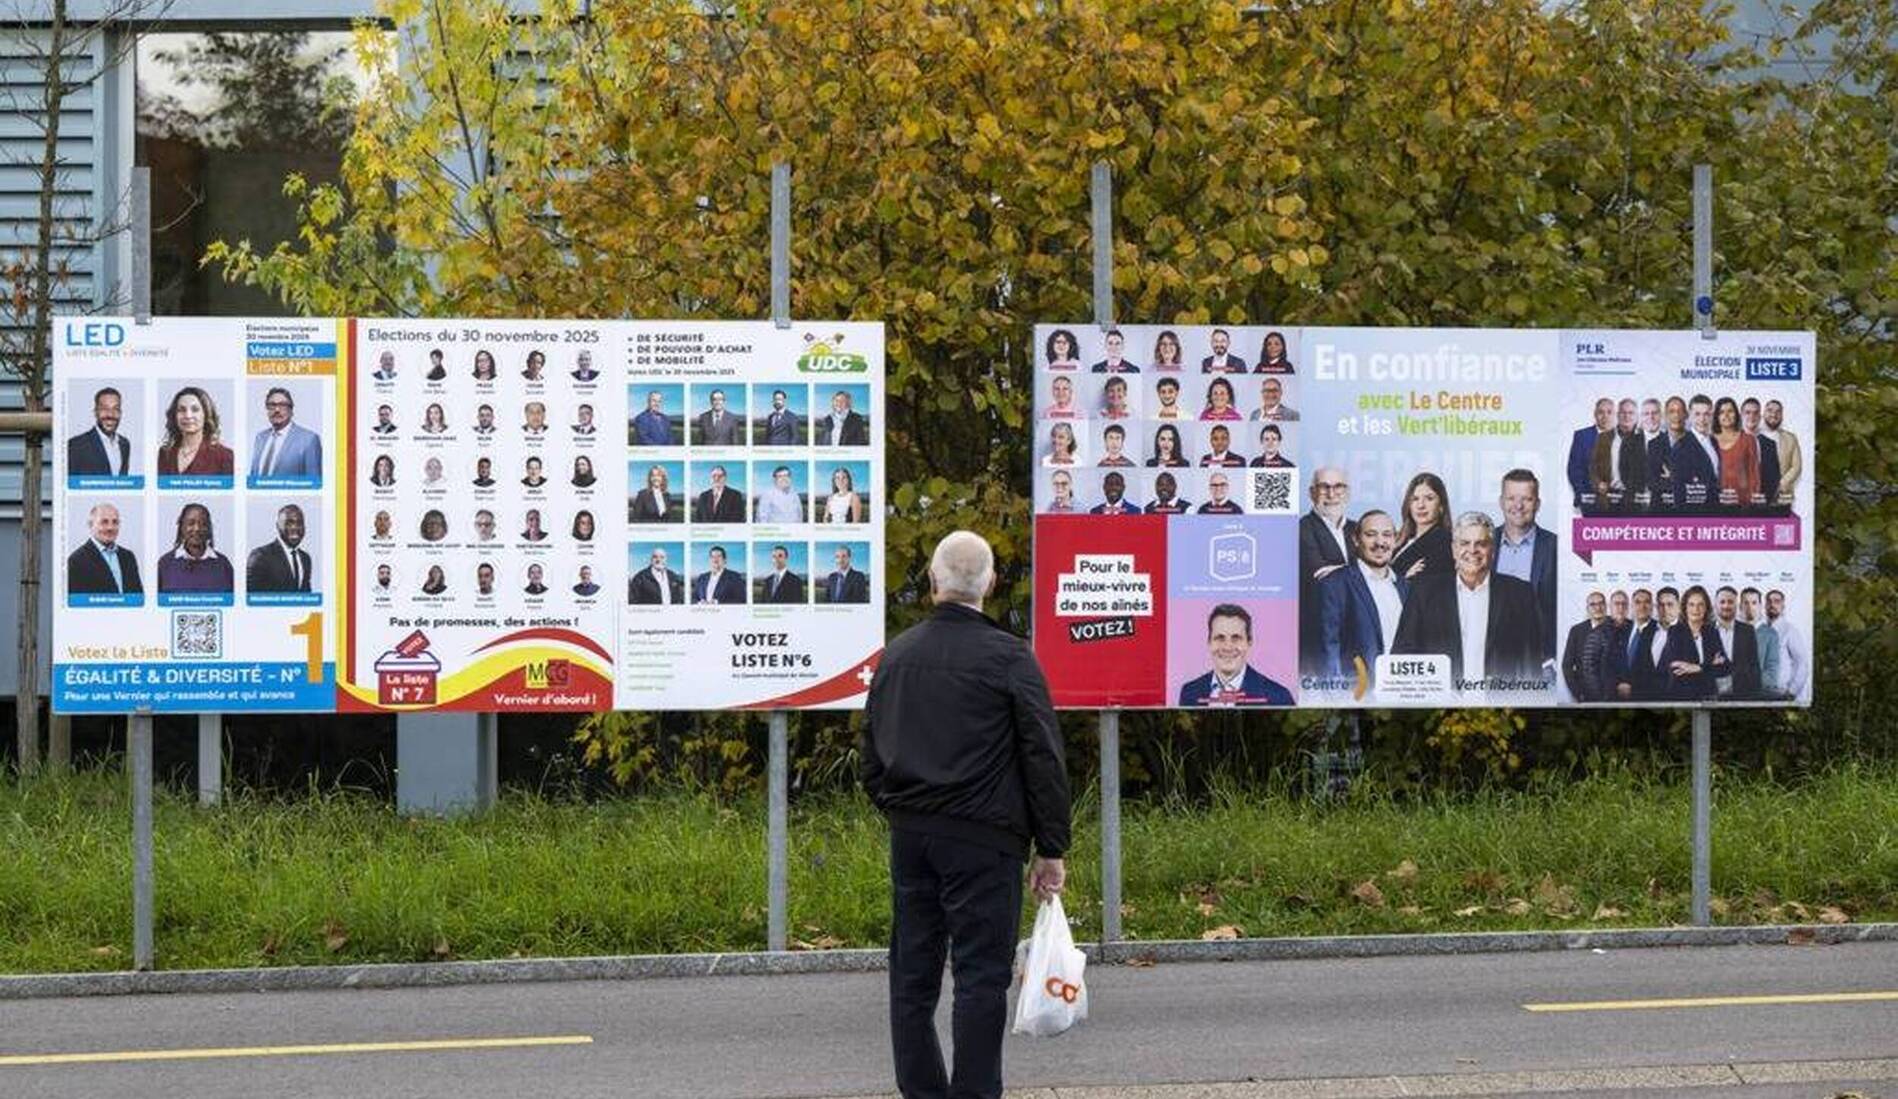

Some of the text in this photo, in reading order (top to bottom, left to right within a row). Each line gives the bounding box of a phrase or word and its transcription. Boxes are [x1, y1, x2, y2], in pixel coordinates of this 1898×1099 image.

[67, 324, 125, 346] LED
[369, 328, 599, 343] Elections du 30 novembre 2025
[637, 332, 704, 342] DE SÉCURITÉ
[250, 345, 315, 356] Votez LED
[637, 345, 752, 353] DE POUVOIR D'ACHAT
[1576, 344, 1605, 354] PLR
[250, 360, 287, 373] Liste
[637, 355, 704, 364] DE MOBILITÉ
[808, 356, 854, 371] UDC
[1315, 343, 1547, 382] En confiance
[1680, 368, 1740, 379] MUNICIPALE
[1750, 362, 1798, 376] LISTE 3
[1358, 391, 1503, 410] avec Le Centre
[1337, 414, 1523, 435] et les Vert'libéraux
[1582, 523, 1767, 541] COMPÉTENCE ET INTÉGRITÉ
[1216, 549, 1238, 563] PS
[1079, 561, 1131, 573] Pour le
[1063, 579, 1146, 592] mieux-vivre
[1060, 599, 1149, 611] de nos aînés
[390, 617, 410, 628] Pas
[415, 617, 429, 628] de
[433, 617, 500, 630] promesses,
[504, 617, 525, 628] des
[529, 617, 569, 628] actions
[732, 633, 789, 647] VOTEZ
[66, 666, 141, 684] ÉGALITÉ
[147, 669, 160, 683] &
[167, 666, 262, 684] DIVERSITÉ
[291, 612, 324, 684] 1
[67, 645, 168, 658] Votez la Liste
[732, 653, 812, 667] LISTE N°6
[528, 662, 569, 681] MCG
[1390, 661, 1436, 675] LISTE 4
[386, 674, 429, 684] La liste
[1301, 676, 1349, 690] Centre
[64, 691, 88, 700] Pour
[115, 691, 151, 700] Vernier
[154, 692, 170, 702] qui
[172, 690, 225, 700] rassemble
[228, 691, 238, 700] et
[241, 692, 256, 702] qui
[259, 692, 295, 700] avance
[415, 687, 424, 701] 7
[494, 693, 540, 704] Vernier
[542, 693, 590, 704] d'abord
